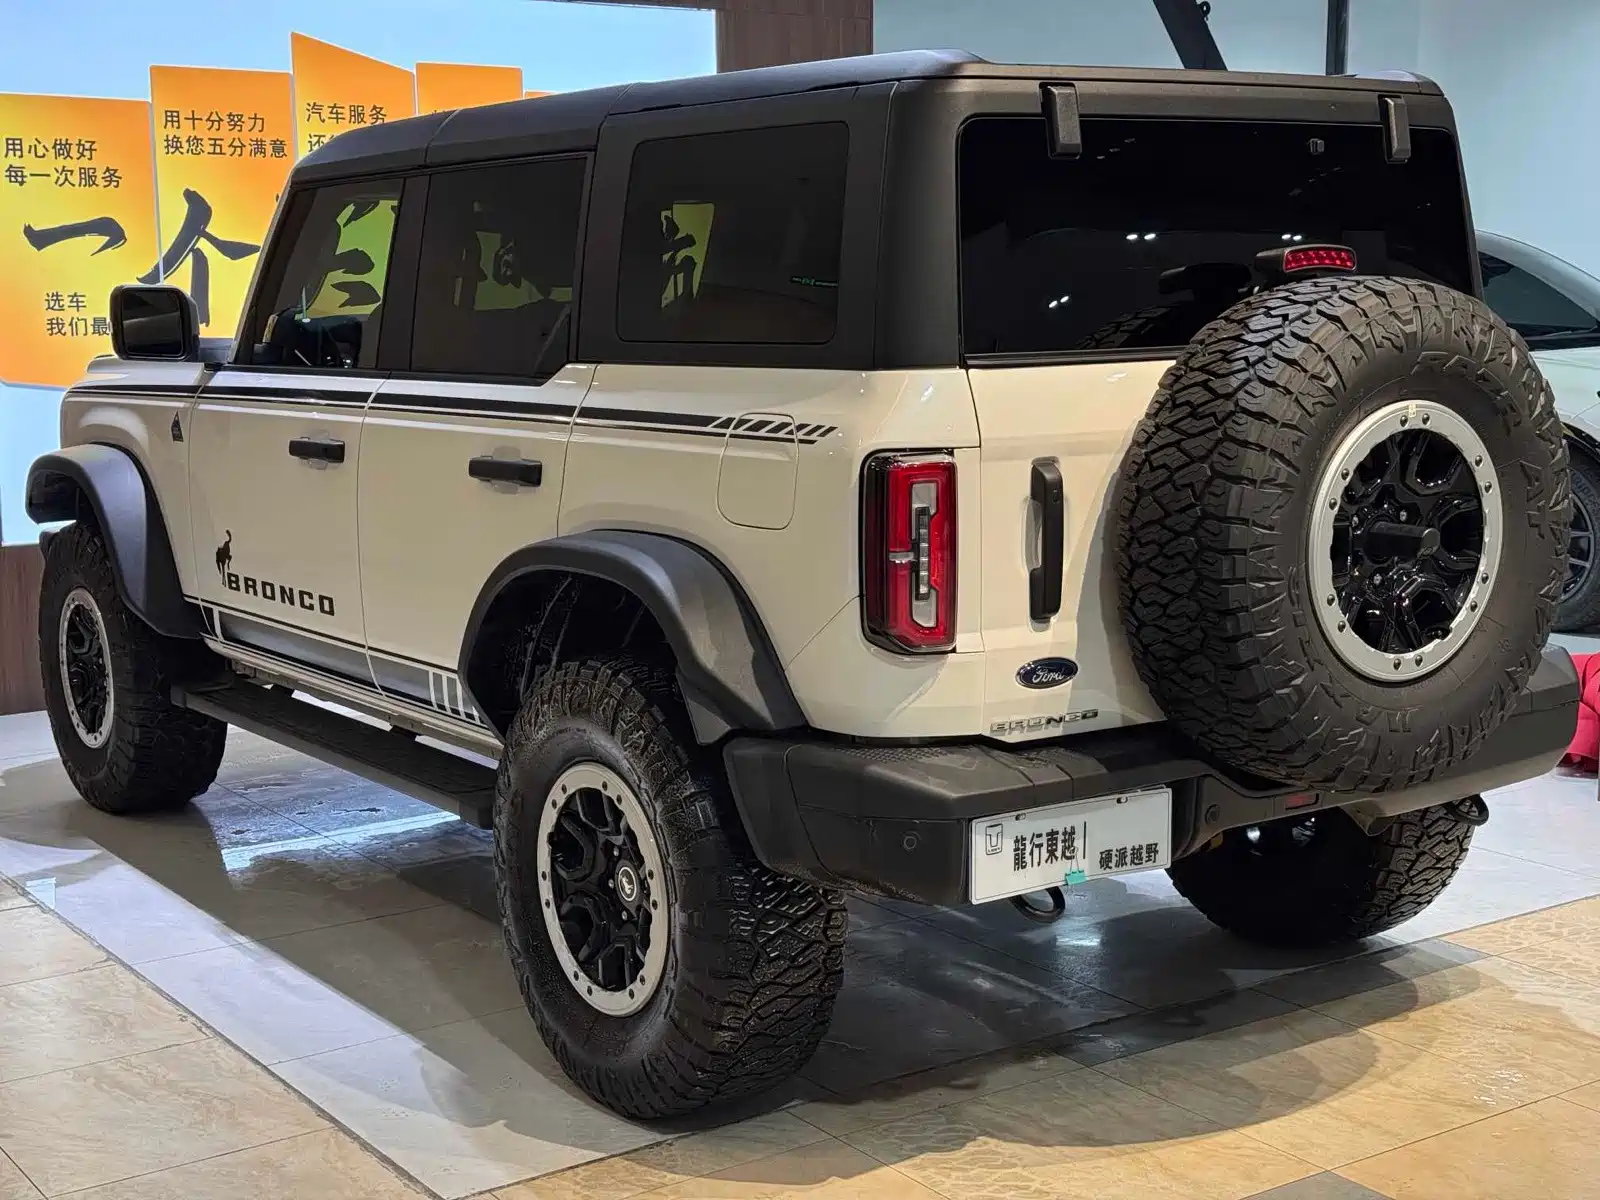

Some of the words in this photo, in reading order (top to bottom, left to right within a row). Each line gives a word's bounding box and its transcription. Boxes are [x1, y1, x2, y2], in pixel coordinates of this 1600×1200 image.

[163, 109, 265, 133] 用十分努力
[306, 102, 387, 124] 汽车服务
[4, 137, 98, 161] 用心做好
[163, 134, 288, 159] 换您五分满意
[4, 164, 123, 188] 每一次服务
[45, 291, 88, 312] 选车
[227, 572, 335, 616] BRONCO
[1032, 665, 1067, 684] Ford
[989, 708, 1099, 732] BRONCO
[1013, 826, 1076, 871] 龍行東越
[1099, 843, 1159, 871] 硬派越野
